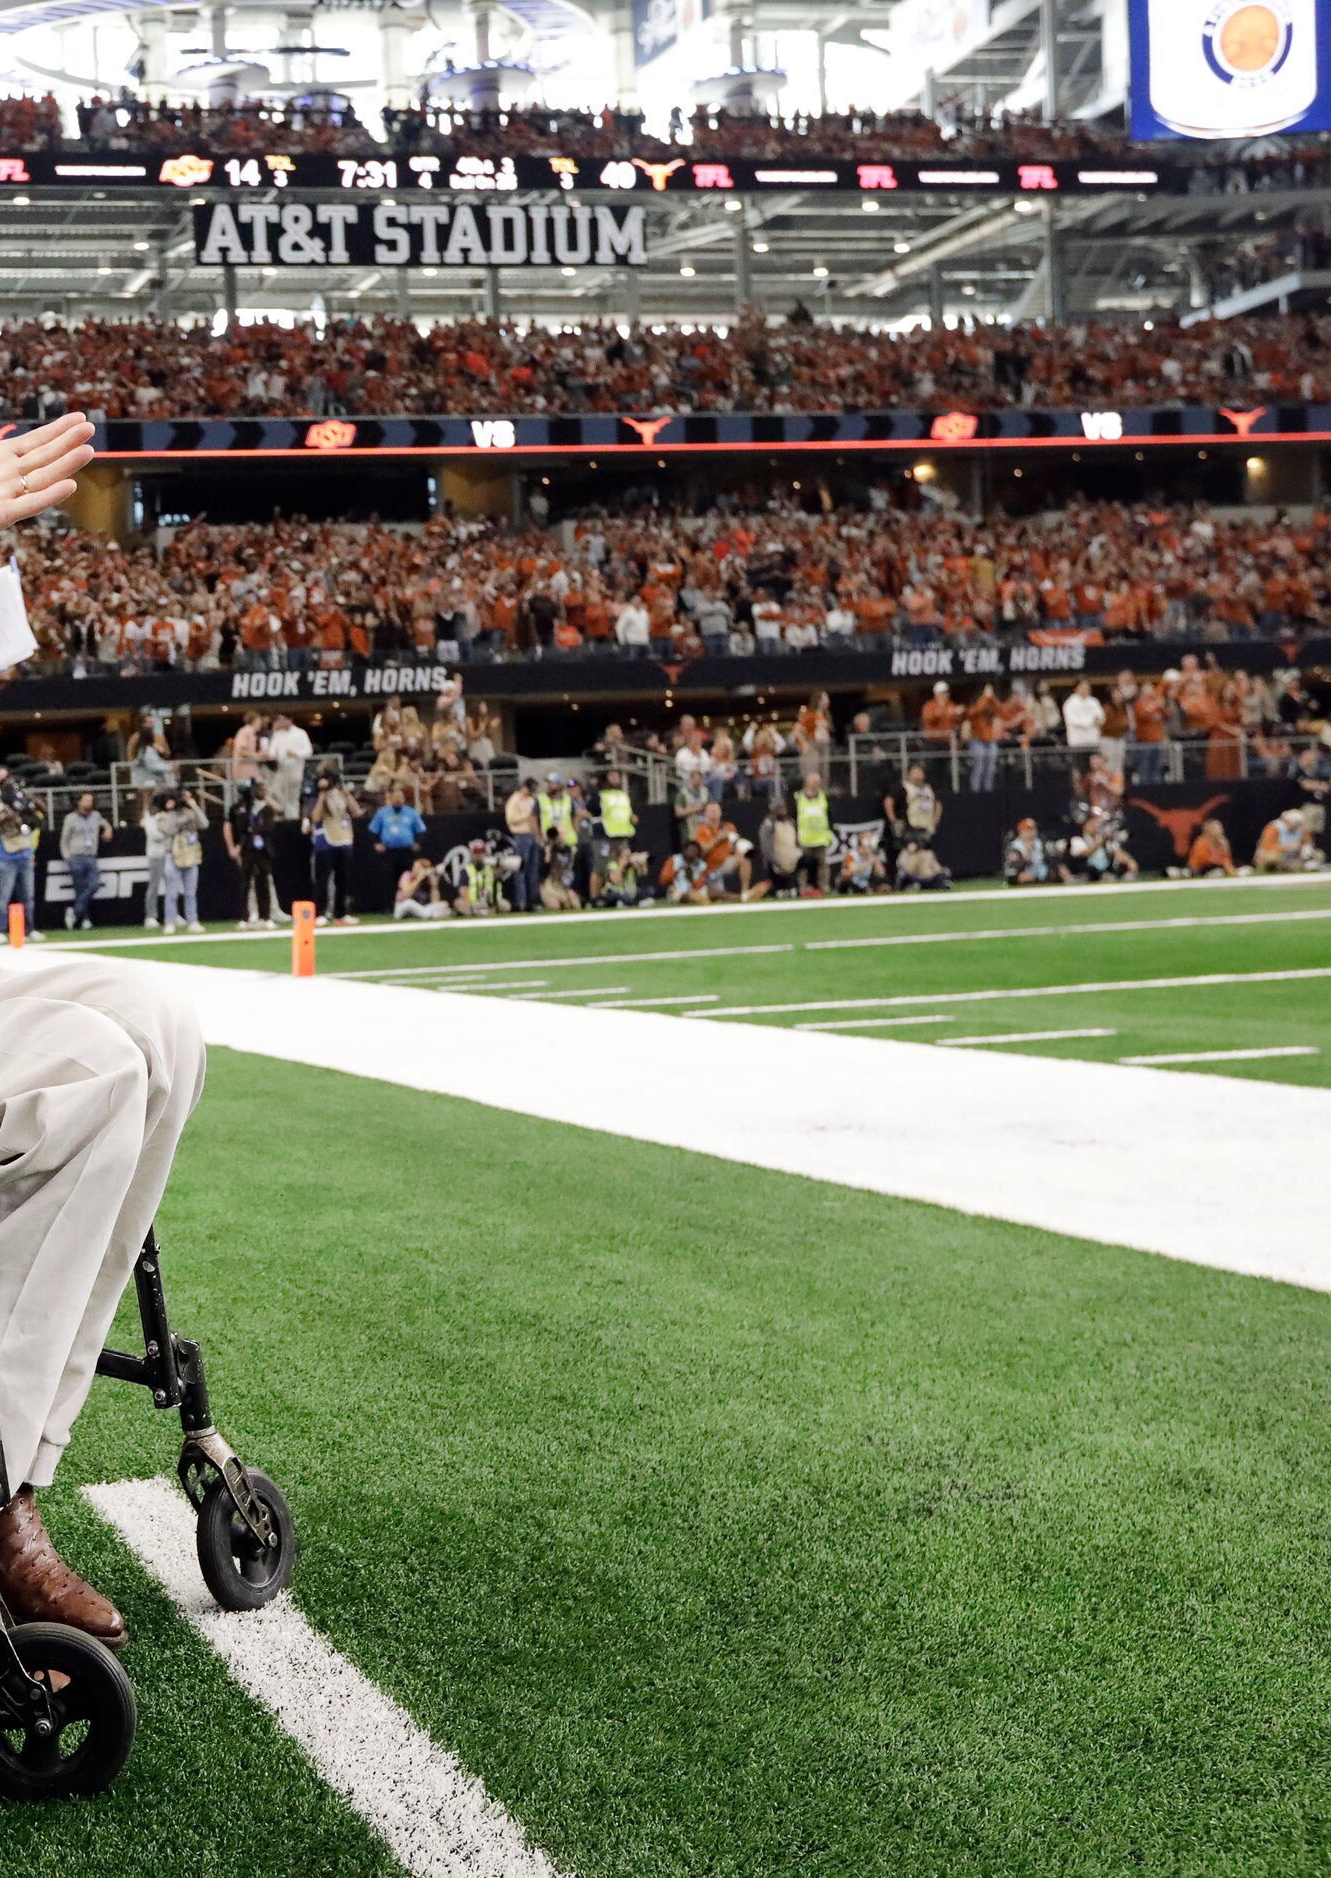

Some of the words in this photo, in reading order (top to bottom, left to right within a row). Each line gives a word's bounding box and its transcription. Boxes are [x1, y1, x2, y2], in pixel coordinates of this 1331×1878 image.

[224, 159, 262, 187] 14
[337, 160, 398, 188] 7:31
[200, 203, 359, 265] AT&T
[373, 203, 648, 265] STADIUM
[471, 420, 516, 449] VS
[891, 649, 954, 677] HOOK
[1009, 642, 1086, 672] HORNS
[231, 671, 301, 698] HOOK
[363, 665, 448, 694] HORNS
